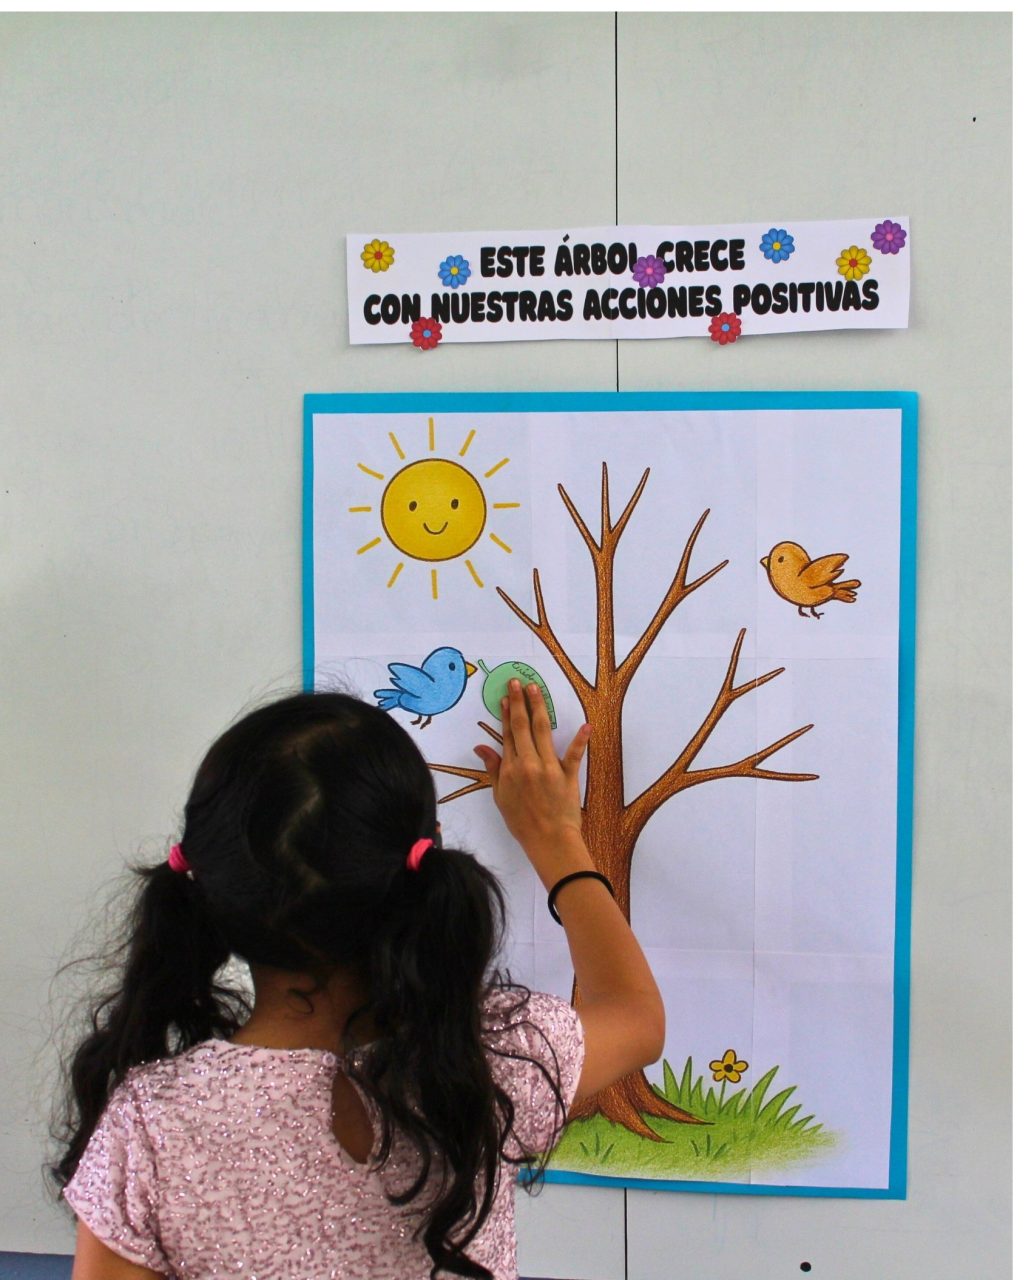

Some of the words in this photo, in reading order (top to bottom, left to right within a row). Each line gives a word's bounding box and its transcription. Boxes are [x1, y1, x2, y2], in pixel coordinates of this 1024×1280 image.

[480, 246, 545, 278] ESTE
[554, 234, 638, 277] ÁRBOL
[656, 239, 745, 273] CRECE
[363, 293, 420, 325] CON
[431, 289, 574, 324] NUESTRAS
[583, 285, 723, 321] ACCIONES
[733, 279, 880, 316] POSITIVAS
